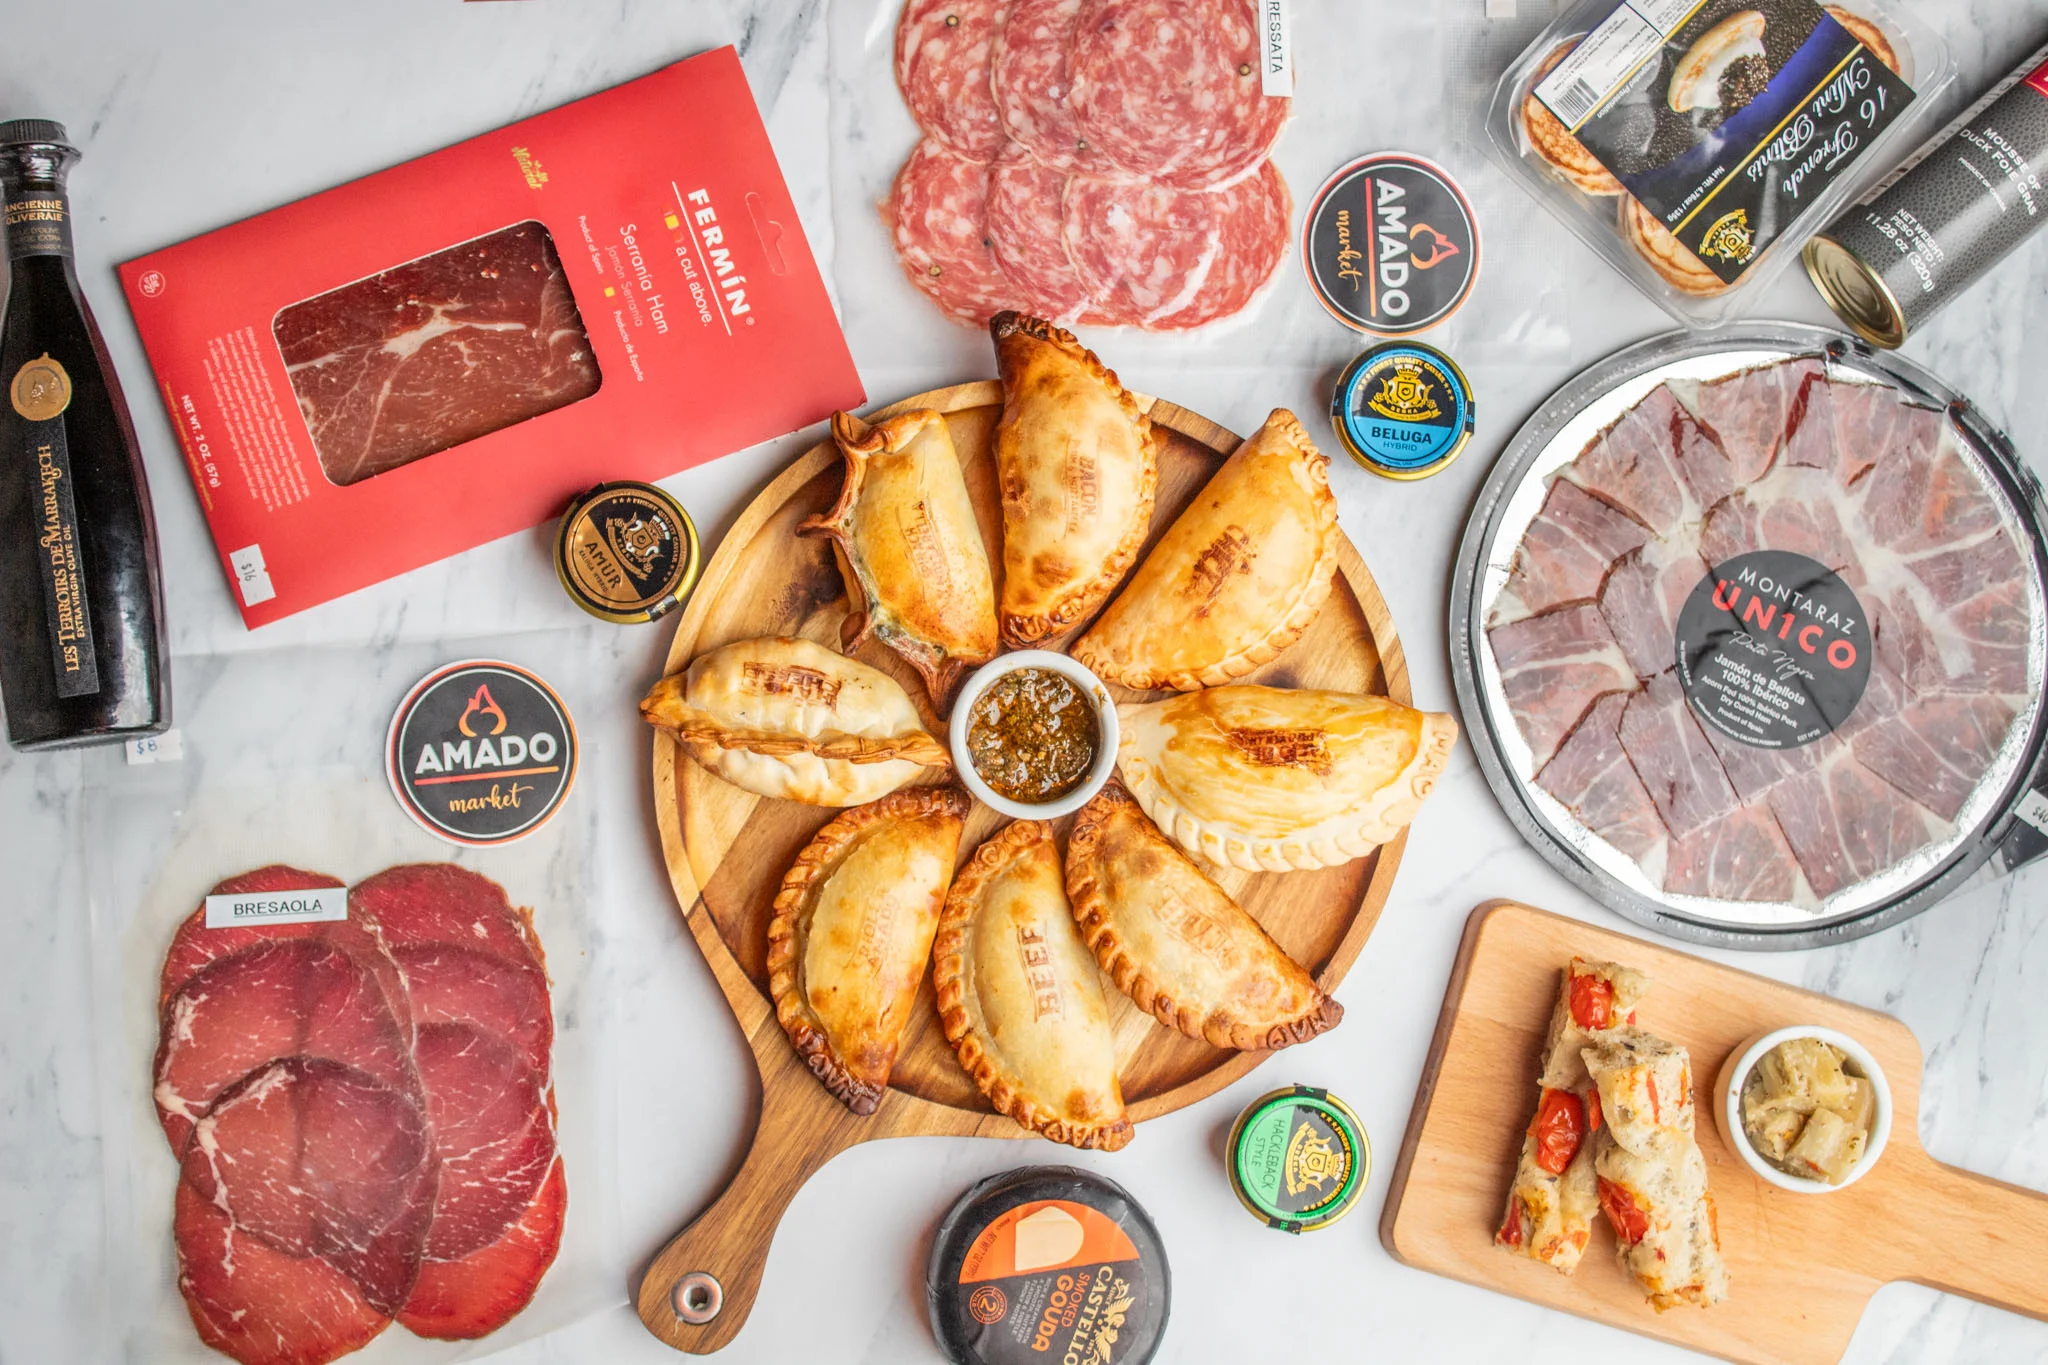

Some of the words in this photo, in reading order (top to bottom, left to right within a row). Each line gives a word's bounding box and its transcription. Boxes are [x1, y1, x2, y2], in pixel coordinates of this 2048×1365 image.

[1809, 57, 1870, 116] Mini
[1857, 84, 1886, 129] 16
[1745, 114, 1816, 181] Blinis
[1780, 122, 1859, 198] French
[1982, 127, 2029, 174] MOUSSE
[2026, 173, 2041, 192] OF
[1710, 165, 1725, 177] Net
[1960, 128, 1991, 152] DUCK
[1990, 150, 2019, 182] FOIE
[2016, 181, 2037, 216] GRAS
[4, 200, 63, 212] ANCIENNE
[6, 213, 62, 224] OLIVERAIE
[577, 215, 594, 243] Product
[1889, 214, 1914, 238] PESO
[1911, 236, 1934, 262] NETO
[1896, 208, 1916, 226] NET
[1913, 223, 1946, 262] WEIGHT:
[587, 243, 597, 252] of
[675, 246, 686, 256] a
[687, 187, 751, 316] FERMÍN
[1335, 209, 1363, 291] market
[1376, 177, 1410, 316] AMADO
[1864, 212, 1898, 240] 11.28
[1893, 236, 1909, 253] oz
[1904, 249, 1936, 293] (320g)
[590, 252, 605, 274] Spain
[618, 223, 656, 291] Serranía
[645, 294, 672, 334] Ham
[679, 257, 699, 279] cut
[604, 244, 628, 279] Jamón
[619, 281, 644, 327] Serranía
[688, 281, 714, 326] above.
[612, 310, 630, 342] Producto
[624, 343, 634, 353] de
[181, 394, 194, 413] NET
[188, 414, 202, 433] WT.
[195, 434, 204, 442] 2
[1371, 426, 1432, 444] BELUGA
[198, 442, 211, 461] OZ.
[1383, 441, 1417, 452] HYBRID
[203, 462, 221, 488] (57g)
[1079, 456, 1097, 516] BACON
[37, 444, 62, 547] MARRAKECH
[63, 524, 71, 539] OIL
[50, 545, 64, 564] DE
[65, 544, 75, 569] OLIVE
[585, 541, 620, 588] AMUR
[69, 573, 80, 605] VIRGIN
[1737, 565, 1855, 635] MONTARAZ
[52, 568, 76, 645] TERROIRS
[74, 607, 85, 637] EXTRA
[63, 645, 79, 671] LES
[1728, 628, 1770, 657] Pata
[1773, 648, 1815, 680] Negra
[1713, 652, 1752, 678] Jamón
[1751, 671, 1766, 686] de
[1767, 678, 1806, 705] Bellota
[1720, 668, 1751, 691] 100%
[1752, 683, 1790, 711] Ibérico
[1700, 675, 1723, 691] Acorn
[1722, 684, 1737, 697] Fed
[1736, 691, 1756, 707] 100%
[1780, 713, 1797, 728] Pork
[1718, 694, 1732, 708] Dry
[1732, 700, 1755, 717] Cured
[1754, 711, 1772, 725] Ham
[1717, 706, 1741, 723] Product
[1740, 717, 1747, 726] of
[1746, 720, 1764, 734] Spain
[415, 731, 557, 774] AMADO
[449, 781, 535, 814] market
[233, 899, 322, 915] BRESAOLA
[1020, 925, 1060, 1016] BEEF
[1251, 1135, 1265, 1167] STYLE
[1261, 1118, 1285, 1190] HACKLEBACK
[985, 1231, 997, 1244] NET
[983, 1301, 996, 1313] 2
[1018, 1280, 1030, 1302] SMOKY
[1023, 1279, 1037, 1304] FLAVOR
[1059, 1271, 1090, 1328] SMOKED
[1104, 1286, 1116, 1306] SINCE
[1008, 1303, 1021, 1325] NOTES
[1015, 1313, 1030, 1343] BUTTERY
[1028, 1299, 1042, 1325] CREAMY
[1031, 1273, 1072, 1351] GOUDA
[1063, 1265, 1114, 1365] CASTELLO
[1021, 1327, 1032, 1344] WITH
